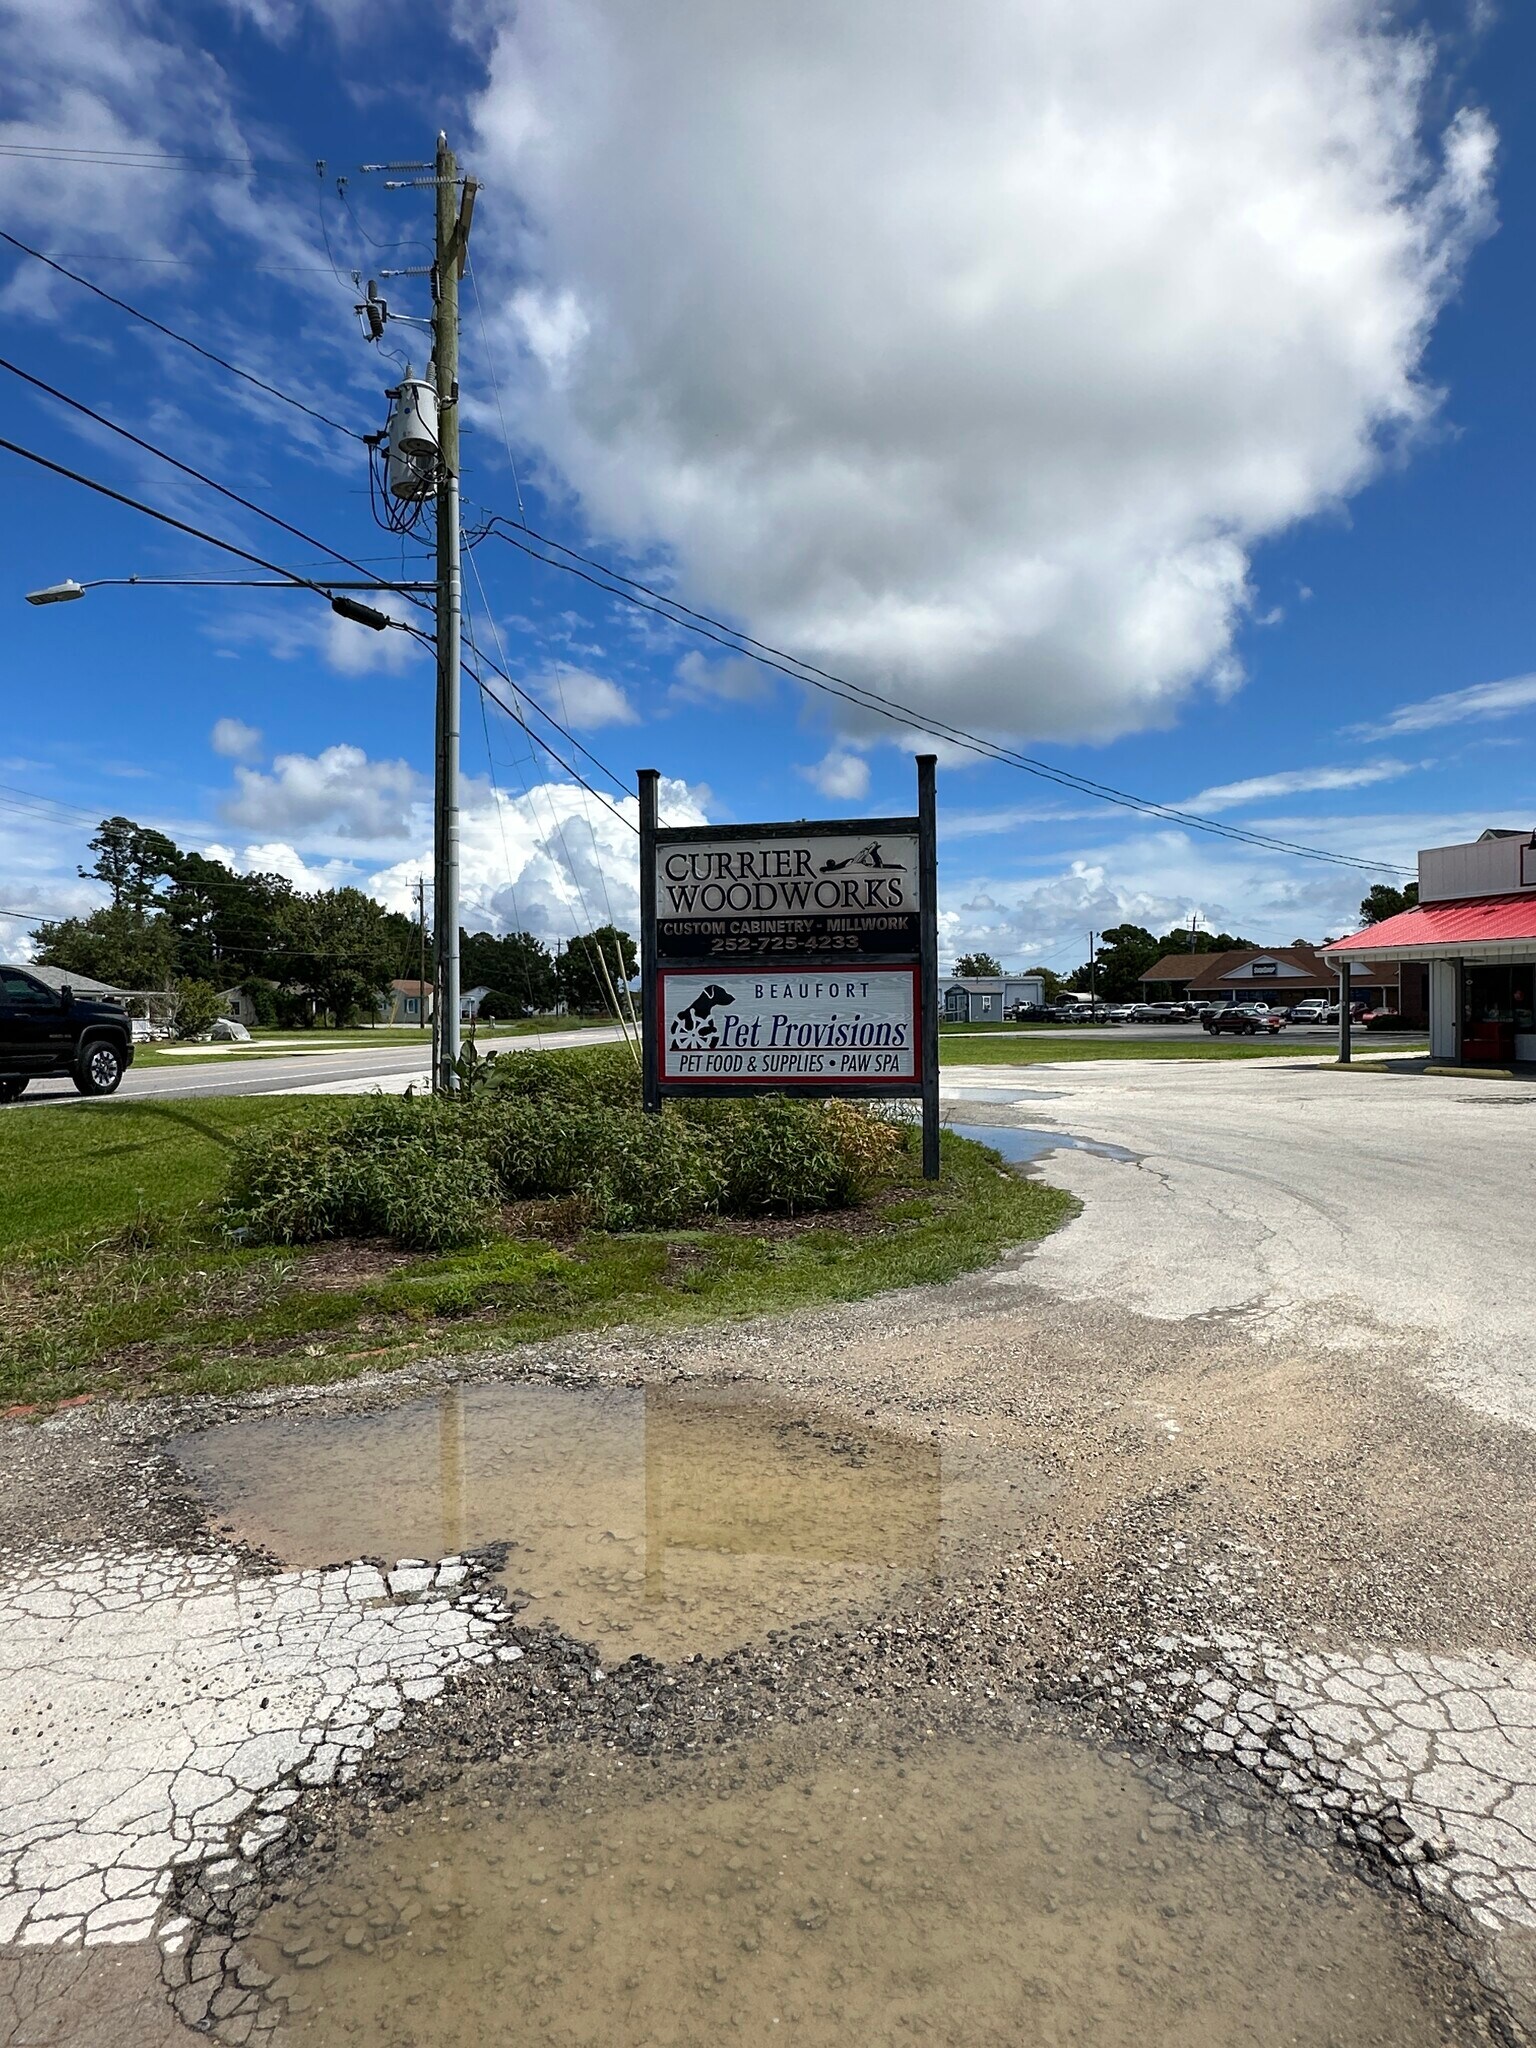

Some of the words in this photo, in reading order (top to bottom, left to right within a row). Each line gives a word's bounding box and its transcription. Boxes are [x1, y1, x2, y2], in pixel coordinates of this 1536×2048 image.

[665, 849, 818, 882] CURRIER
[666, 878, 904, 912] WOODWORKS
[664, 921, 726, 935] CUSTOM
[730, 919, 814, 933] CABINETRY
[827, 916, 909, 931] MILLWORK
[711, 935, 859, 951] 252-725-4233
[755, 982, 870, 999] BEAUFORT
[720, 1014, 762, 1047] Pet
[768, 1014, 908, 1047] Provisions
[679, 1055, 703, 1072] PET
[706, 1055, 743, 1072] FOOD
[746, 1056, 757, 1072] &
[762, 1054, 824, 1072] SUPPLIES
[840, 1054, 872, 1072] PAW
[874, 1054, 900, 1072] SPA
